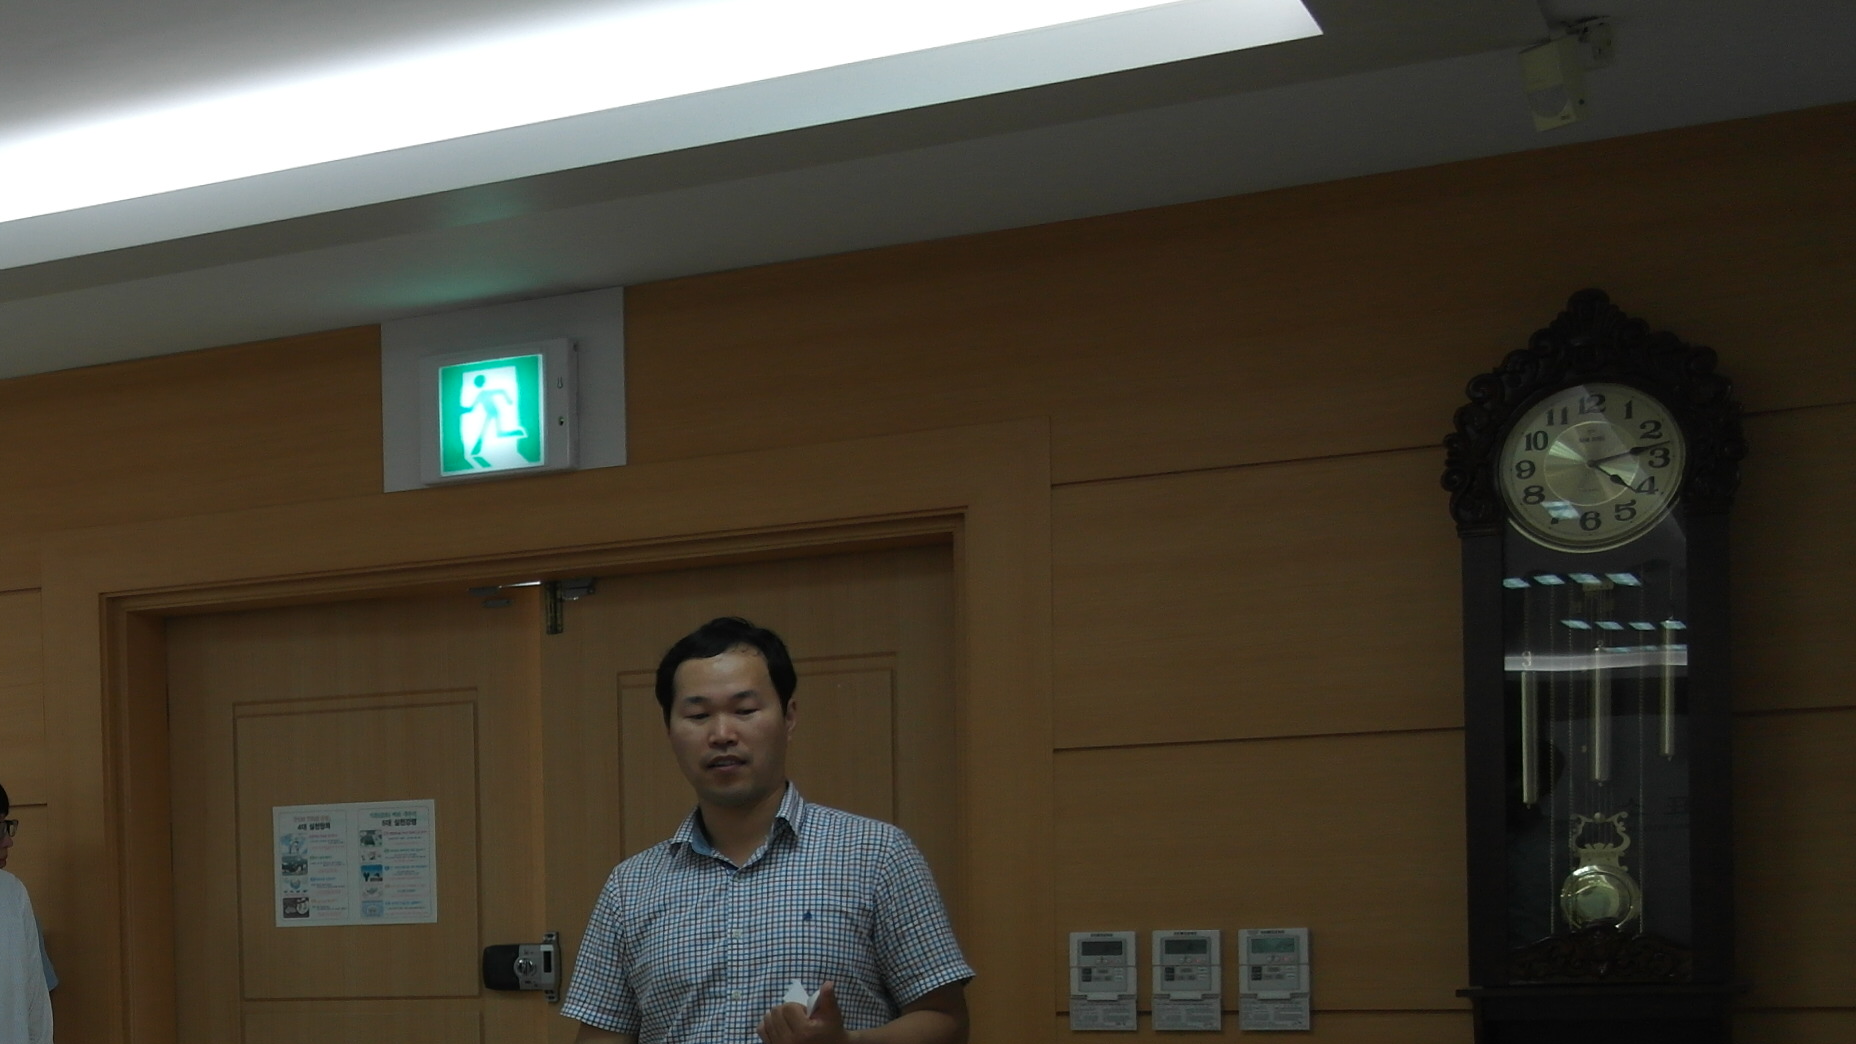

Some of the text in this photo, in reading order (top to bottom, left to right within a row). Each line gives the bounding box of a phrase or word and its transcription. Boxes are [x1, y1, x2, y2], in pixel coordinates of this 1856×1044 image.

[1579, 394, 1606, 415] 12
[1624, 400, 1634, 419] 1
[1546, 407, 1568, 426] 11
[1640, 420, 1663, 439] 2
[1525, 430, 1548, 451] 10
[1648, 447, 1671, 468] 3
[1515, 460, 1536, 479] 9
[1523, 485, 1545, 505] 8
[1637, 476, 1659, 495] 4
[1615, 500, 1637, 521] 5
[1580, 511, 1601, 531] 6
